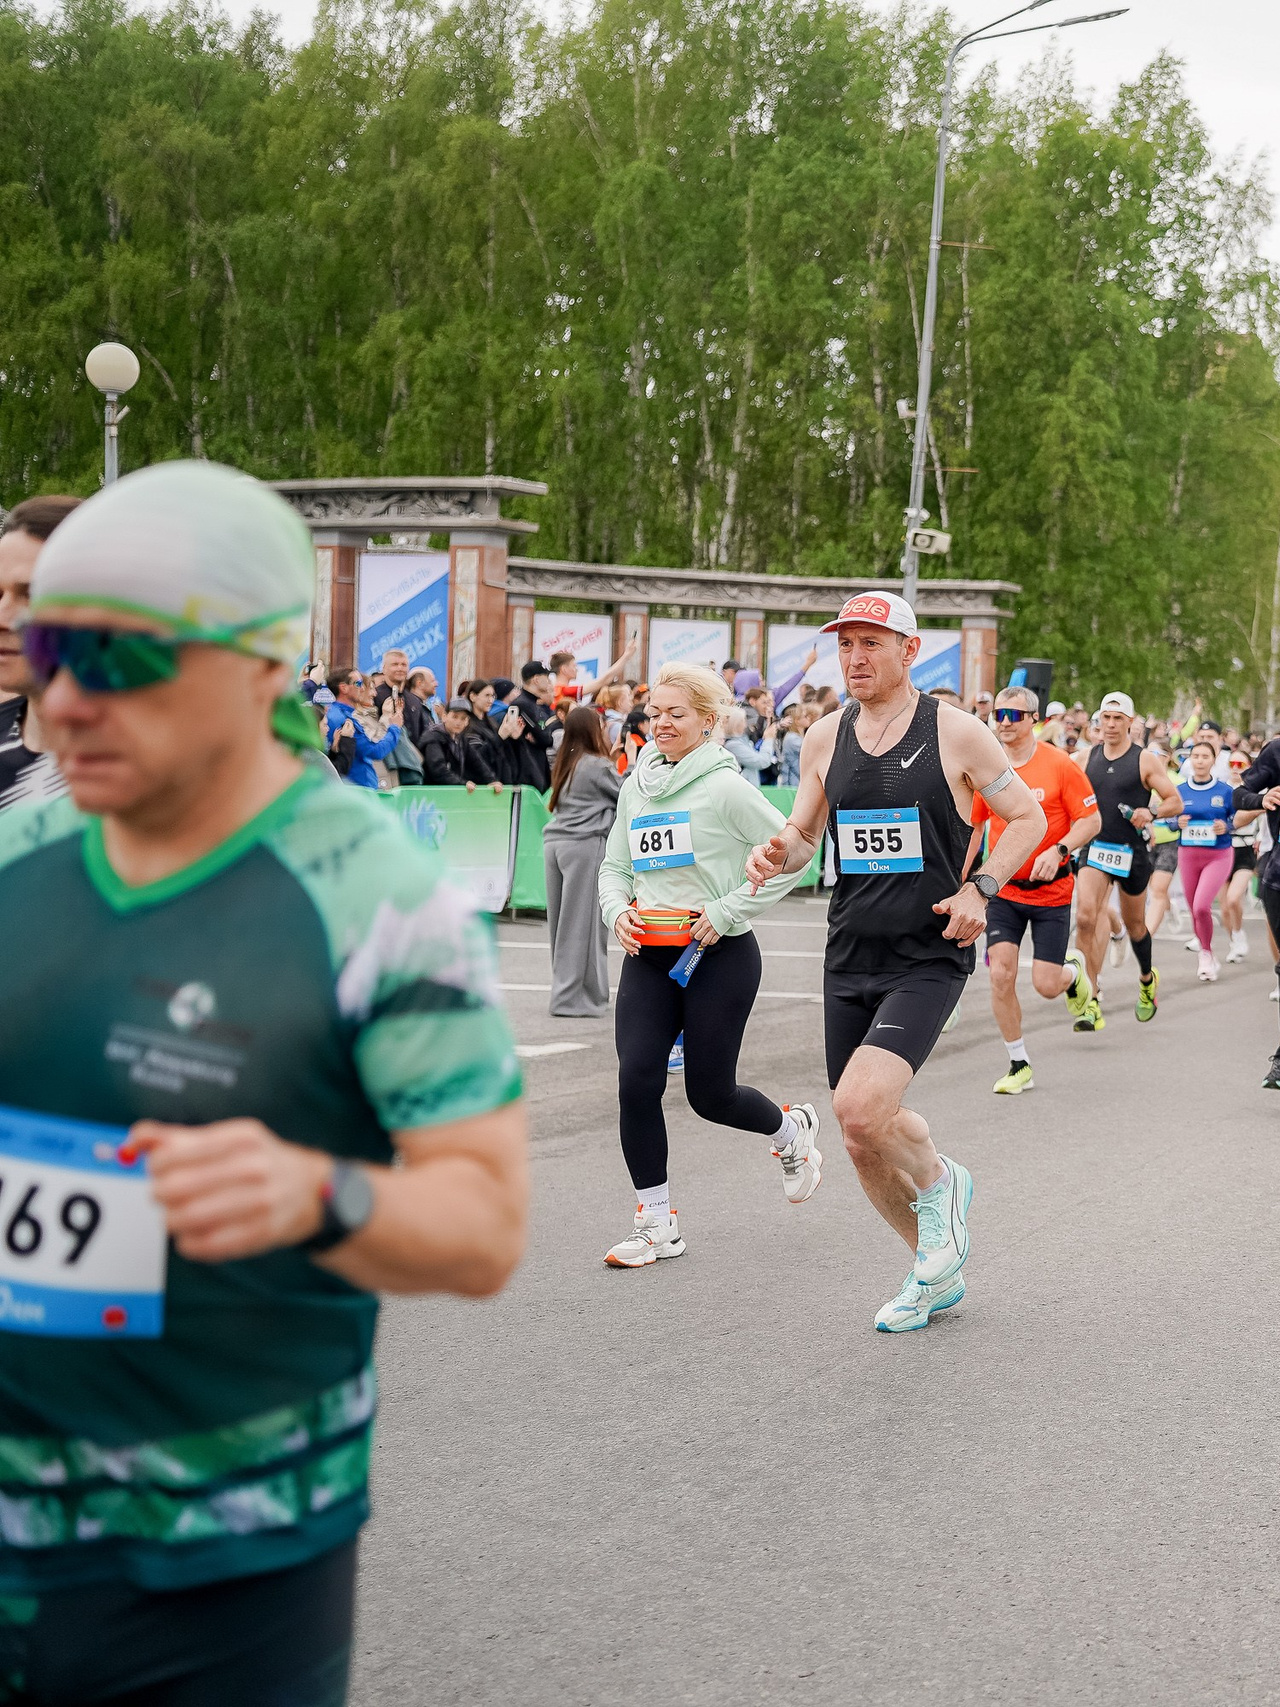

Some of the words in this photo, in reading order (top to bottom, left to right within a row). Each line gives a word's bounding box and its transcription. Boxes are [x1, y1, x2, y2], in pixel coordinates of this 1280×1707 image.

[369, 599, 444, 661] ДВИЖЕНИЕ
[640, 829, 674, 853] 681
[853, 828, 903, 854] 555
[1097, 852, 1122, 866] 888
[0, 1178, 102, 1268] 69
